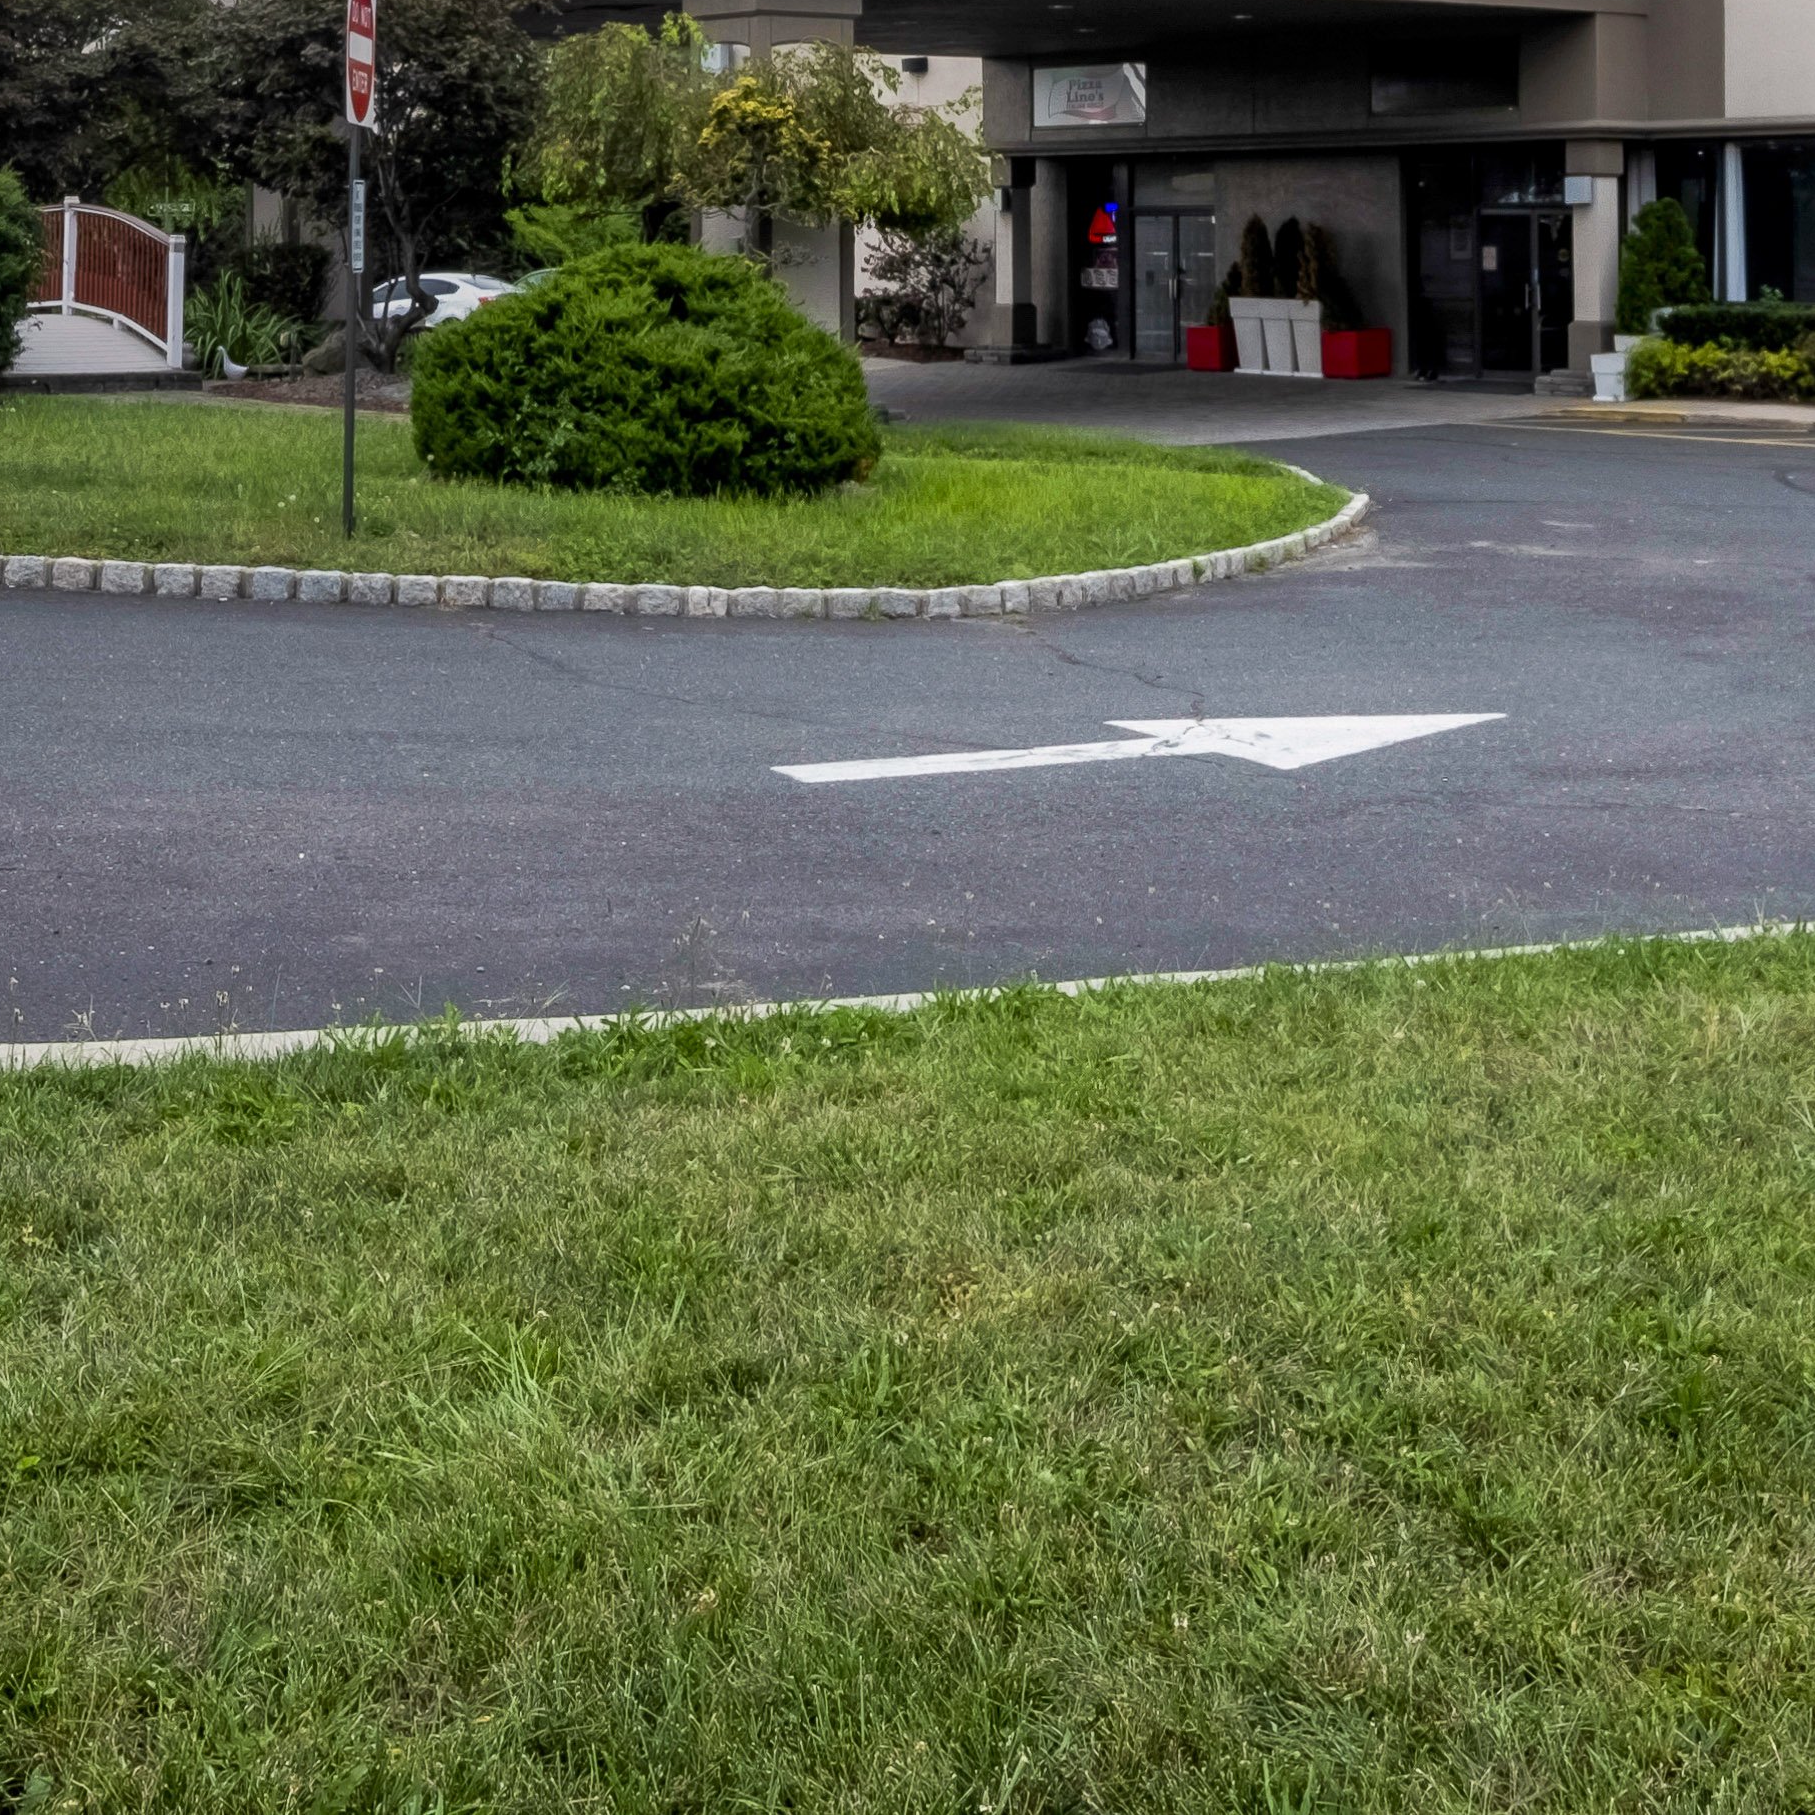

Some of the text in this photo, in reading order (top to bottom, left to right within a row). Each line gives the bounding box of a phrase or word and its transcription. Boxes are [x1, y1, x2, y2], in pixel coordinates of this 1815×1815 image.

[351, 0, 372, 28] DO NOT
[352, 69, 368, 94] ENTER
[1068, 78, 1102, 91] Pizza
[1066, 89, 1104, 103] Lino's
